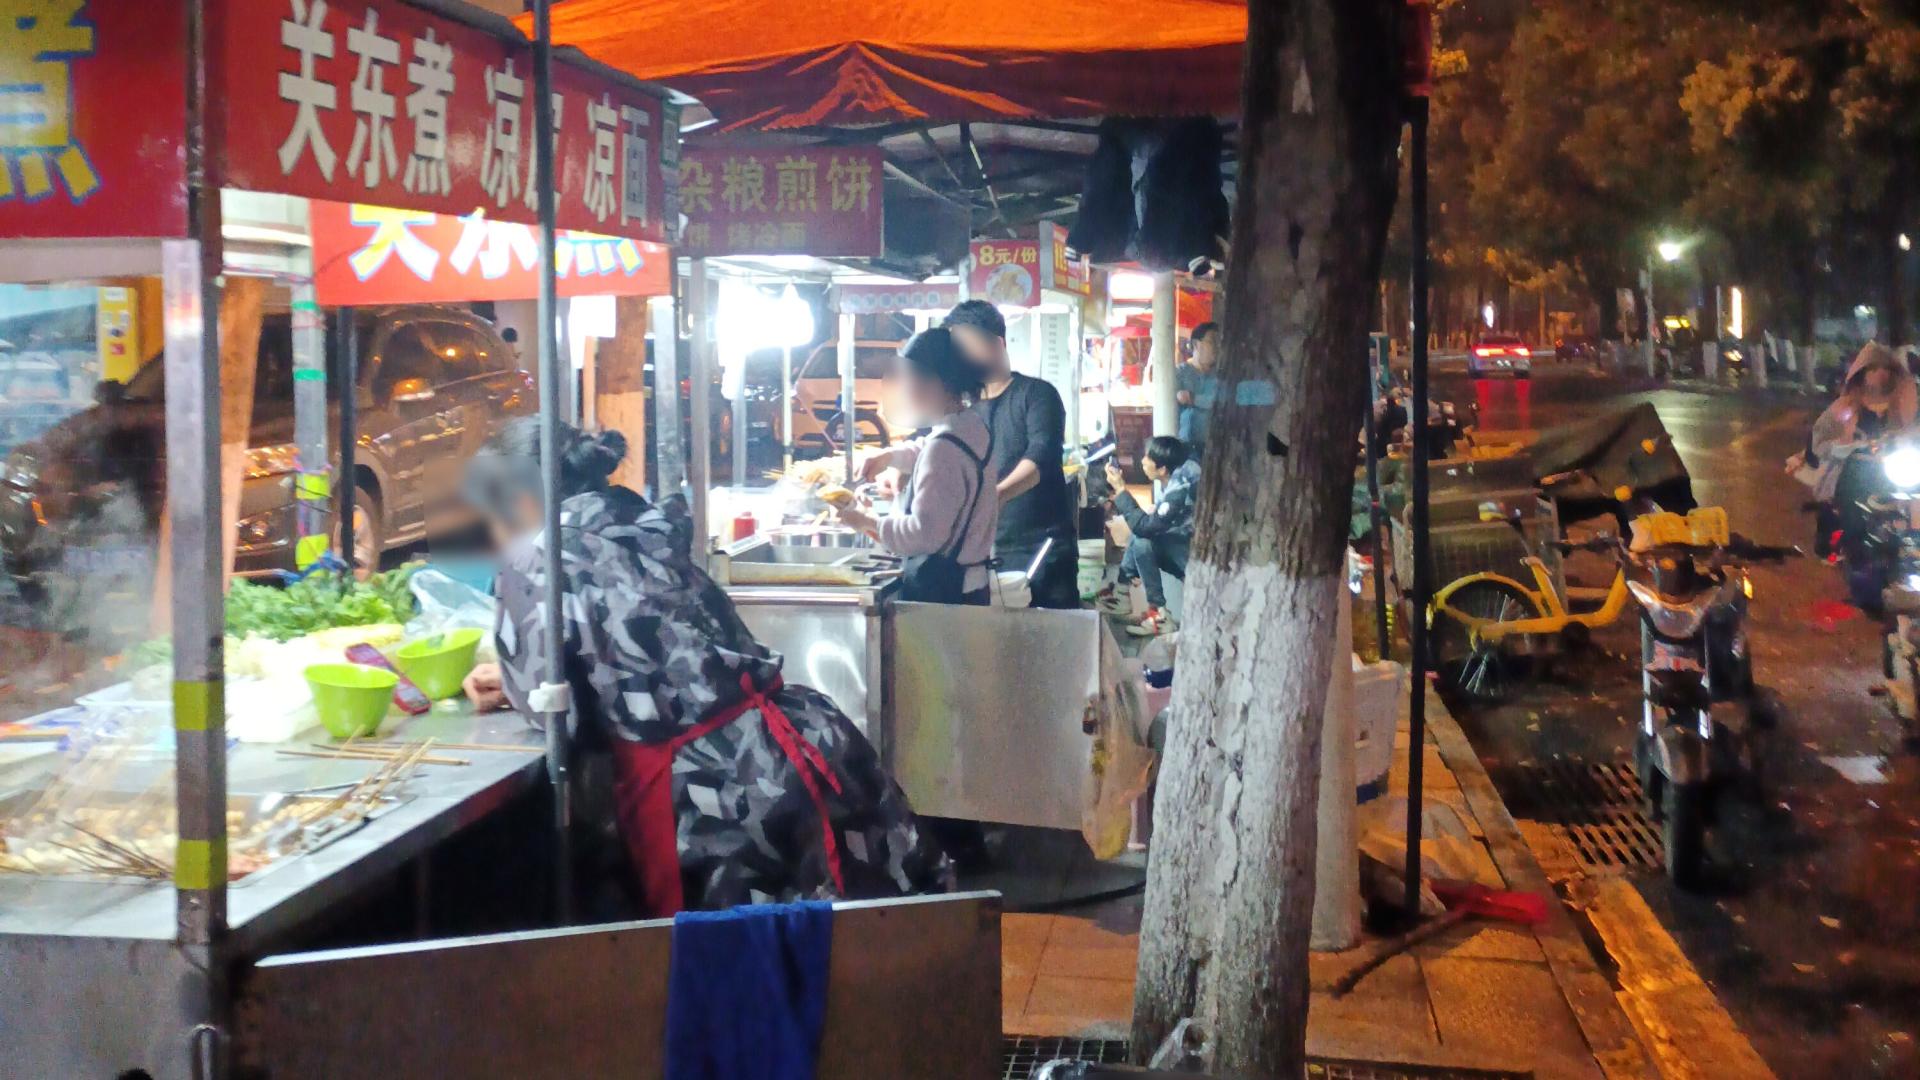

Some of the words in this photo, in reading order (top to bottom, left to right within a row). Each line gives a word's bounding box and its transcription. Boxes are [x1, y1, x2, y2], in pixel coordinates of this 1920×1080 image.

[278, 0, 456, 196] 关东煮
[679, 155, 873, 214] 杂粮煎饼
[980, 244, 1037, 266] 8元/份
